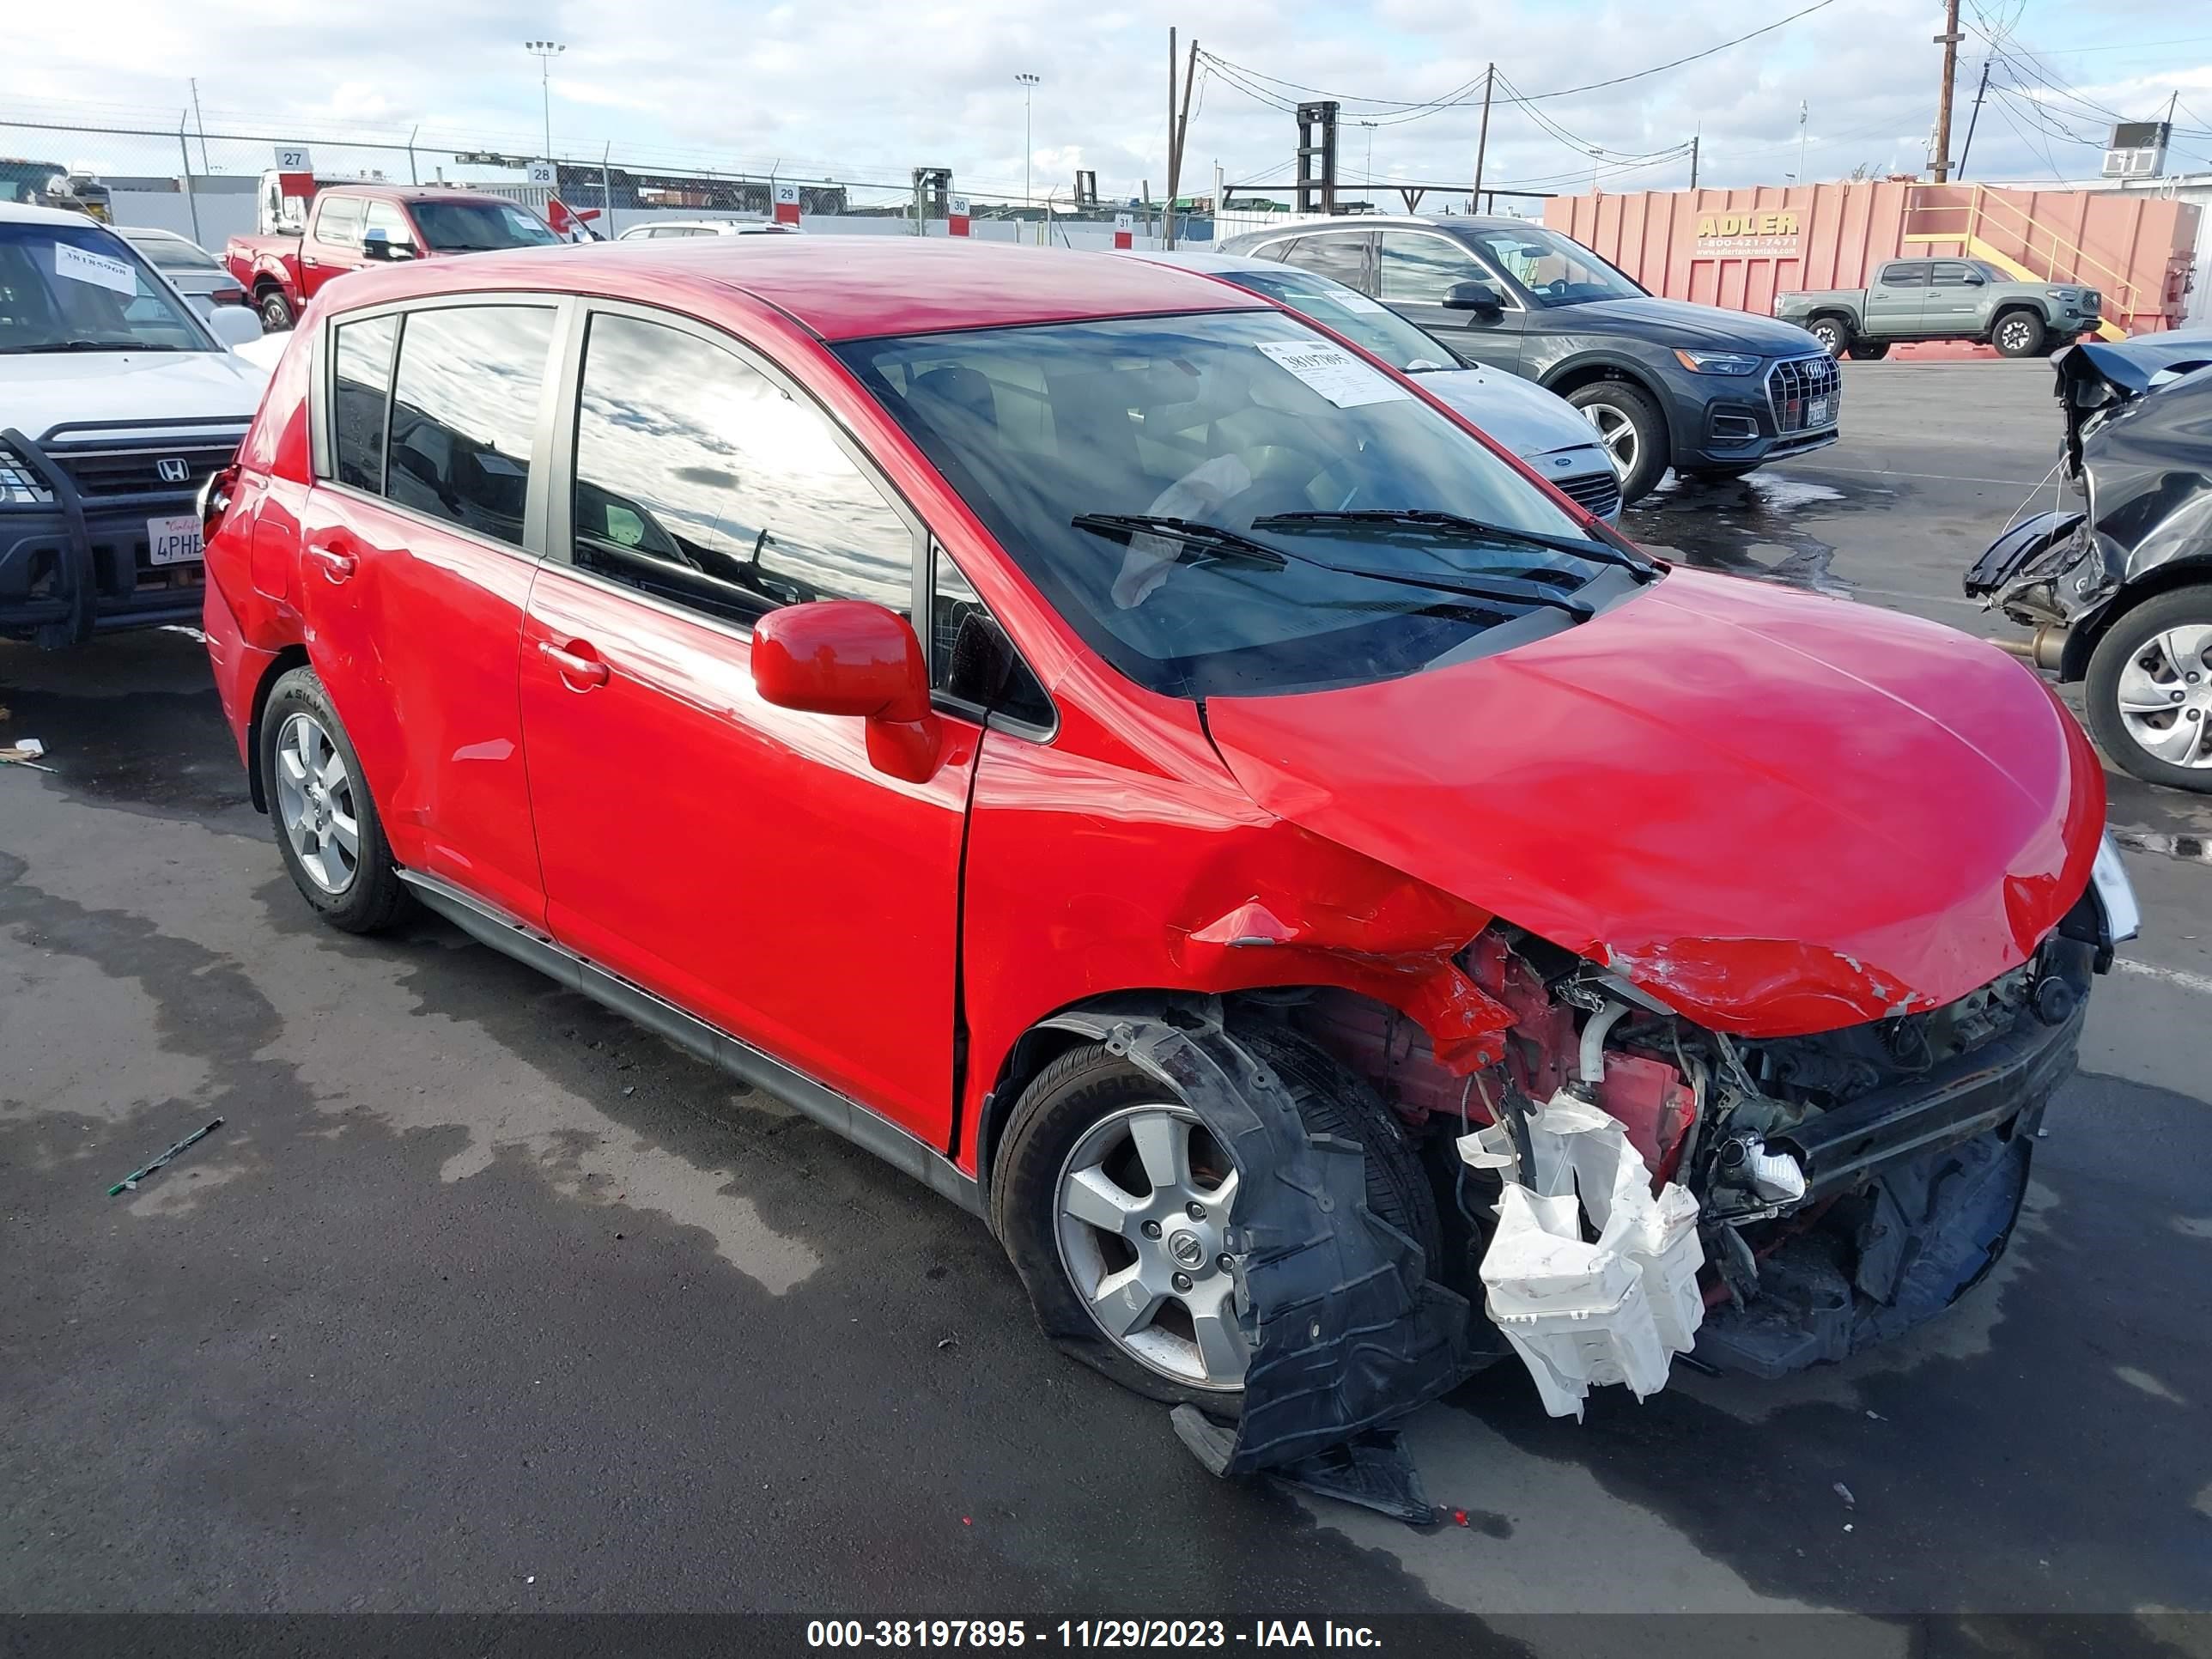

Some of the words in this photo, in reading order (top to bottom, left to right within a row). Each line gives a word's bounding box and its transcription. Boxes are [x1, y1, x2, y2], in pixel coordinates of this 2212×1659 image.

[283, 153, 302, 166] 27
[534, 168, 550, 180] 28
[781, 188, 794, 200] 29
[954, 200, 966, 211] 30
[1120, 218, 1129, 228] 31
[1698, 214, 1799, 238] ADLER
[1697, 238, 1797, 246] 1-800-421-7471
[1696, 246, 1796, 256] www.adlertankrentals.com
[1282, 353, 1351, 370] 38197895
[157, 533, 204, 559] 4PHE
